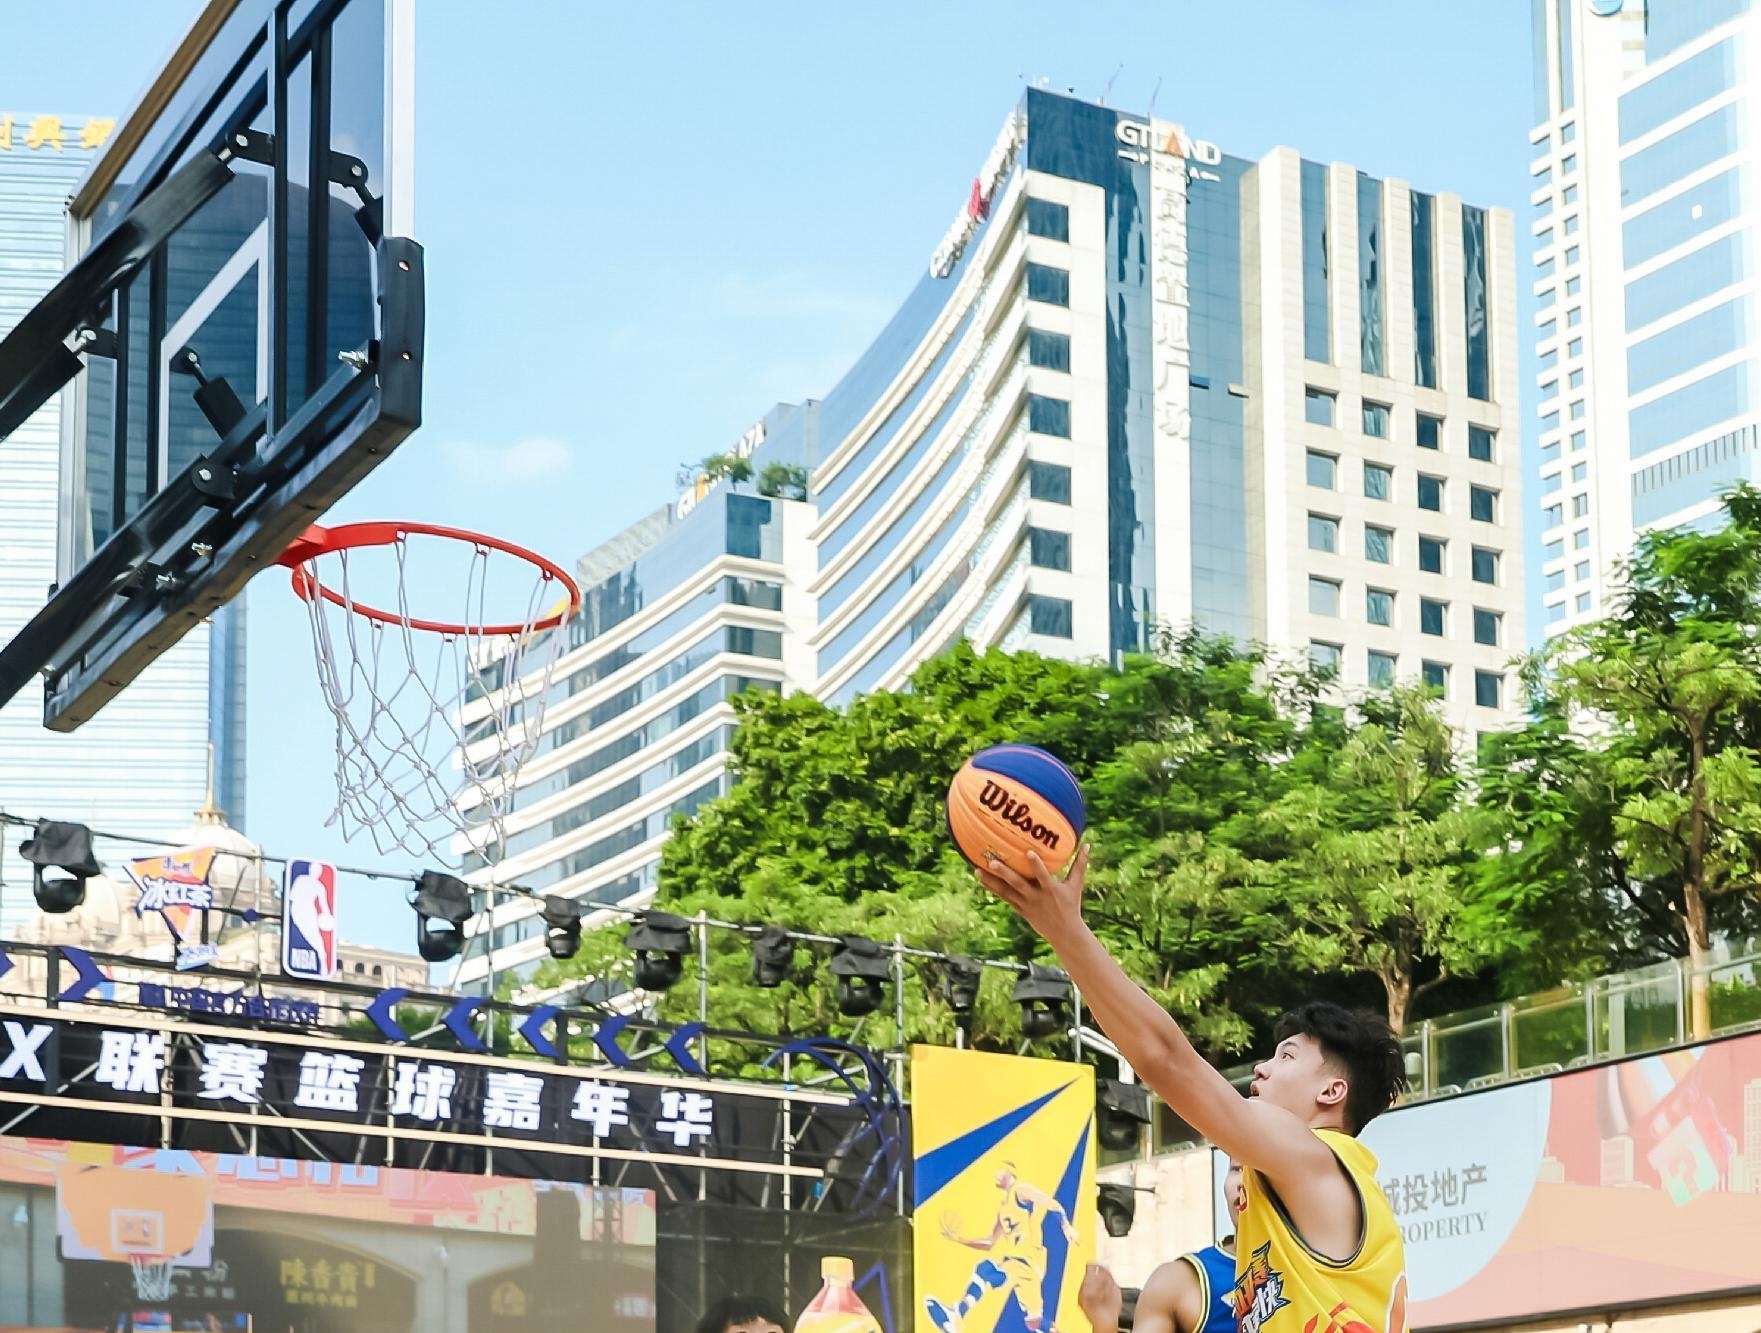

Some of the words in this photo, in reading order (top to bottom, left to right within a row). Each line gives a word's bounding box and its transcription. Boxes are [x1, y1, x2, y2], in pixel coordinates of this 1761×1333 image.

[979, 780, 1060, 850] Wilson
[138, 876, 213, 919] 冰红茶
[290, 947, 319, 972] NBA
